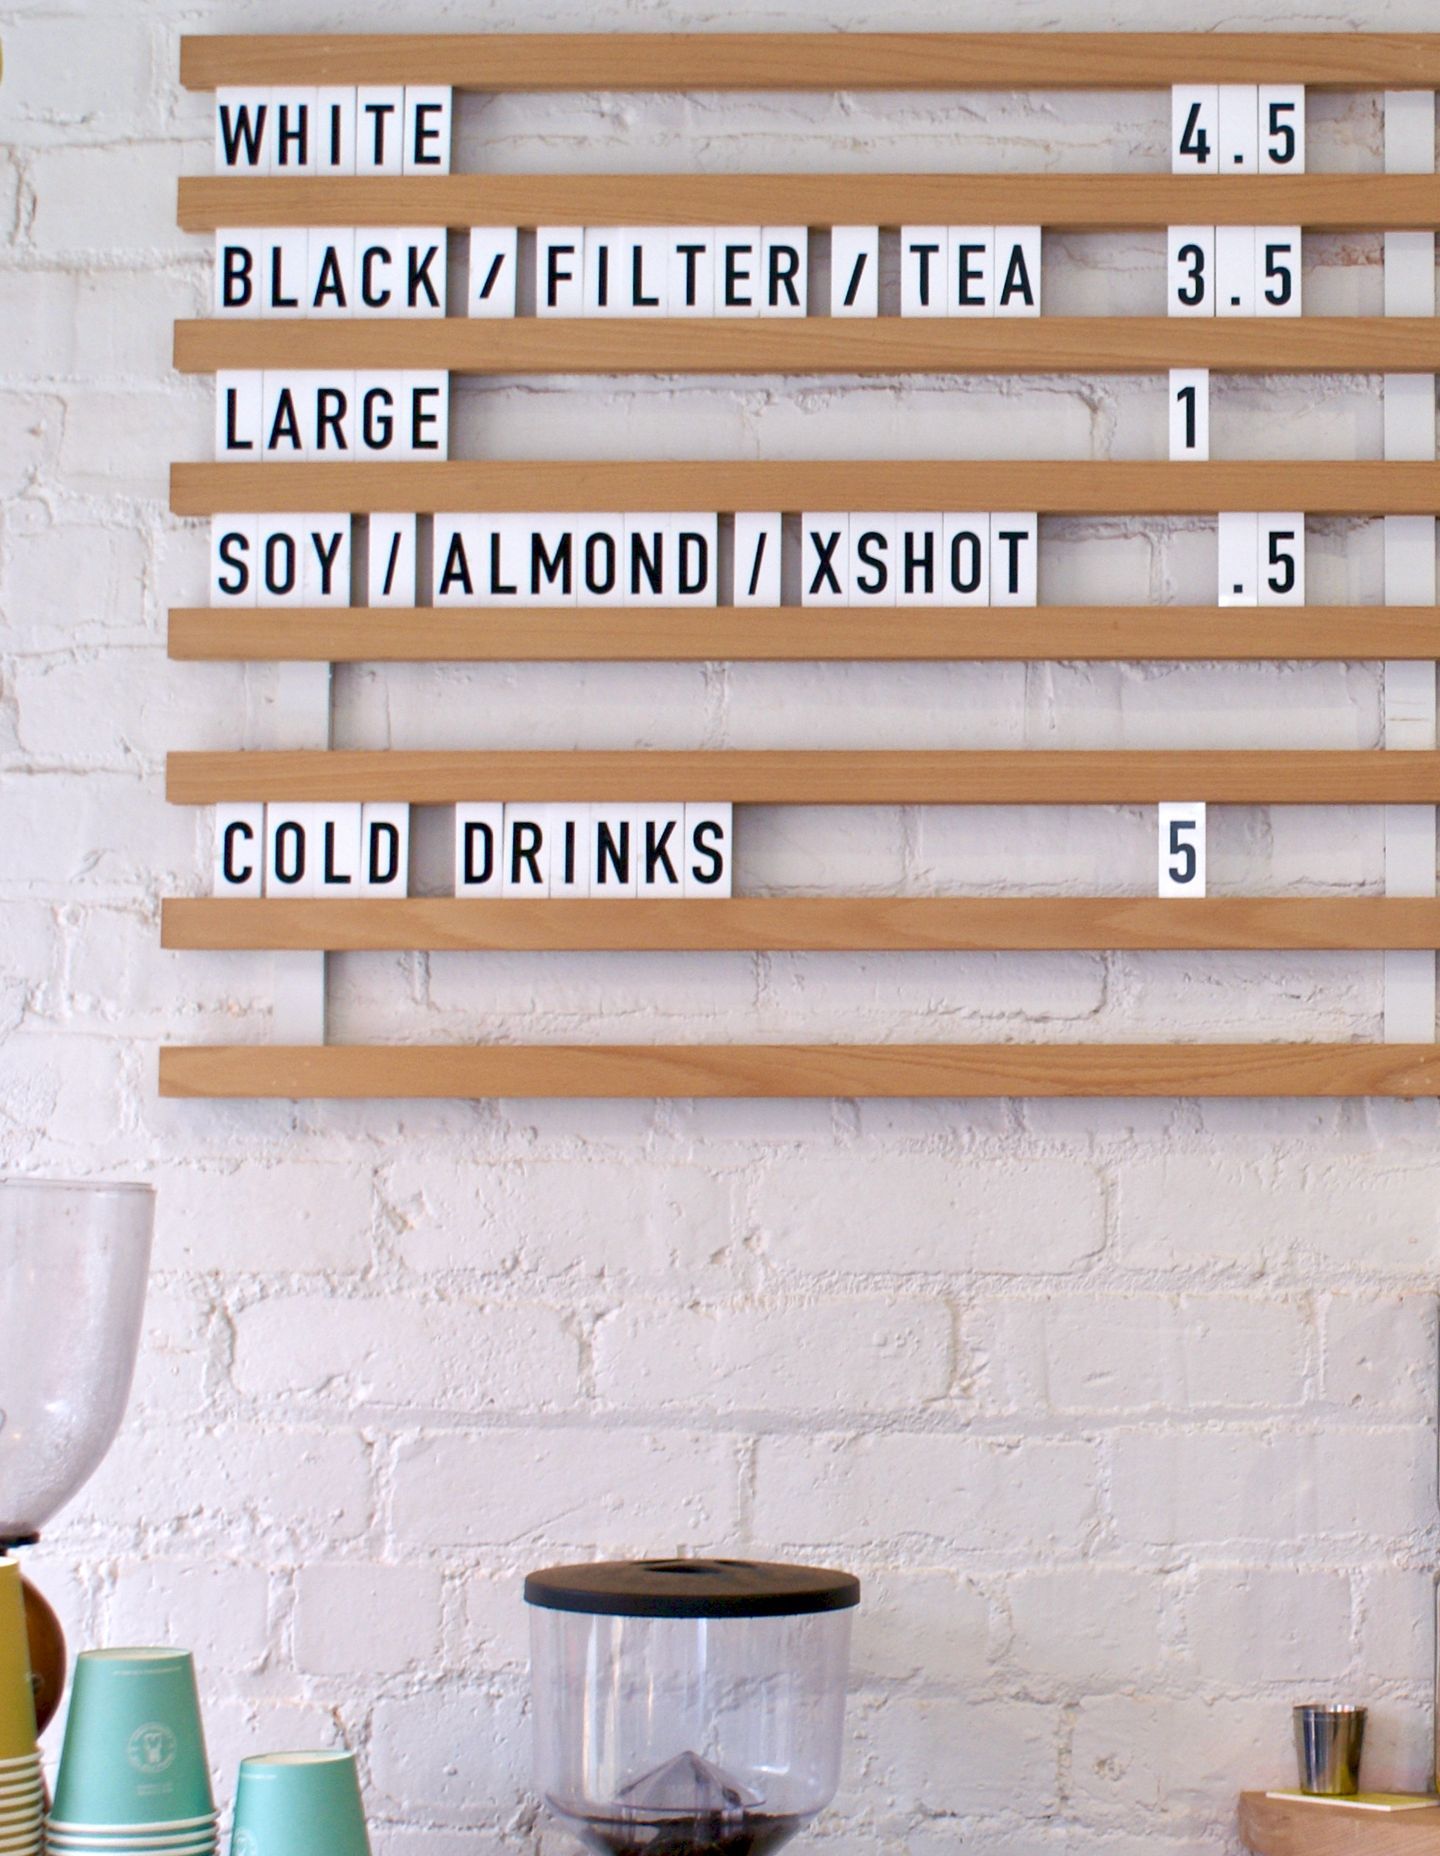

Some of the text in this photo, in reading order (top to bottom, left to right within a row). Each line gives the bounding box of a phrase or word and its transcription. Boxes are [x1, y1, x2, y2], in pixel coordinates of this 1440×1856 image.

[219, 102, 1295, 166] WHITE 4.5
[223, 243, 1292, 308] BLACK / FILTER / TEA 3.5
[226, 386, 1196, 451] LARGE 1
[218, 530, 1295, 596] SOY / ALMOND / XSHOT .5
[223, 820, 1196, 885] COLD DRINKS 5
